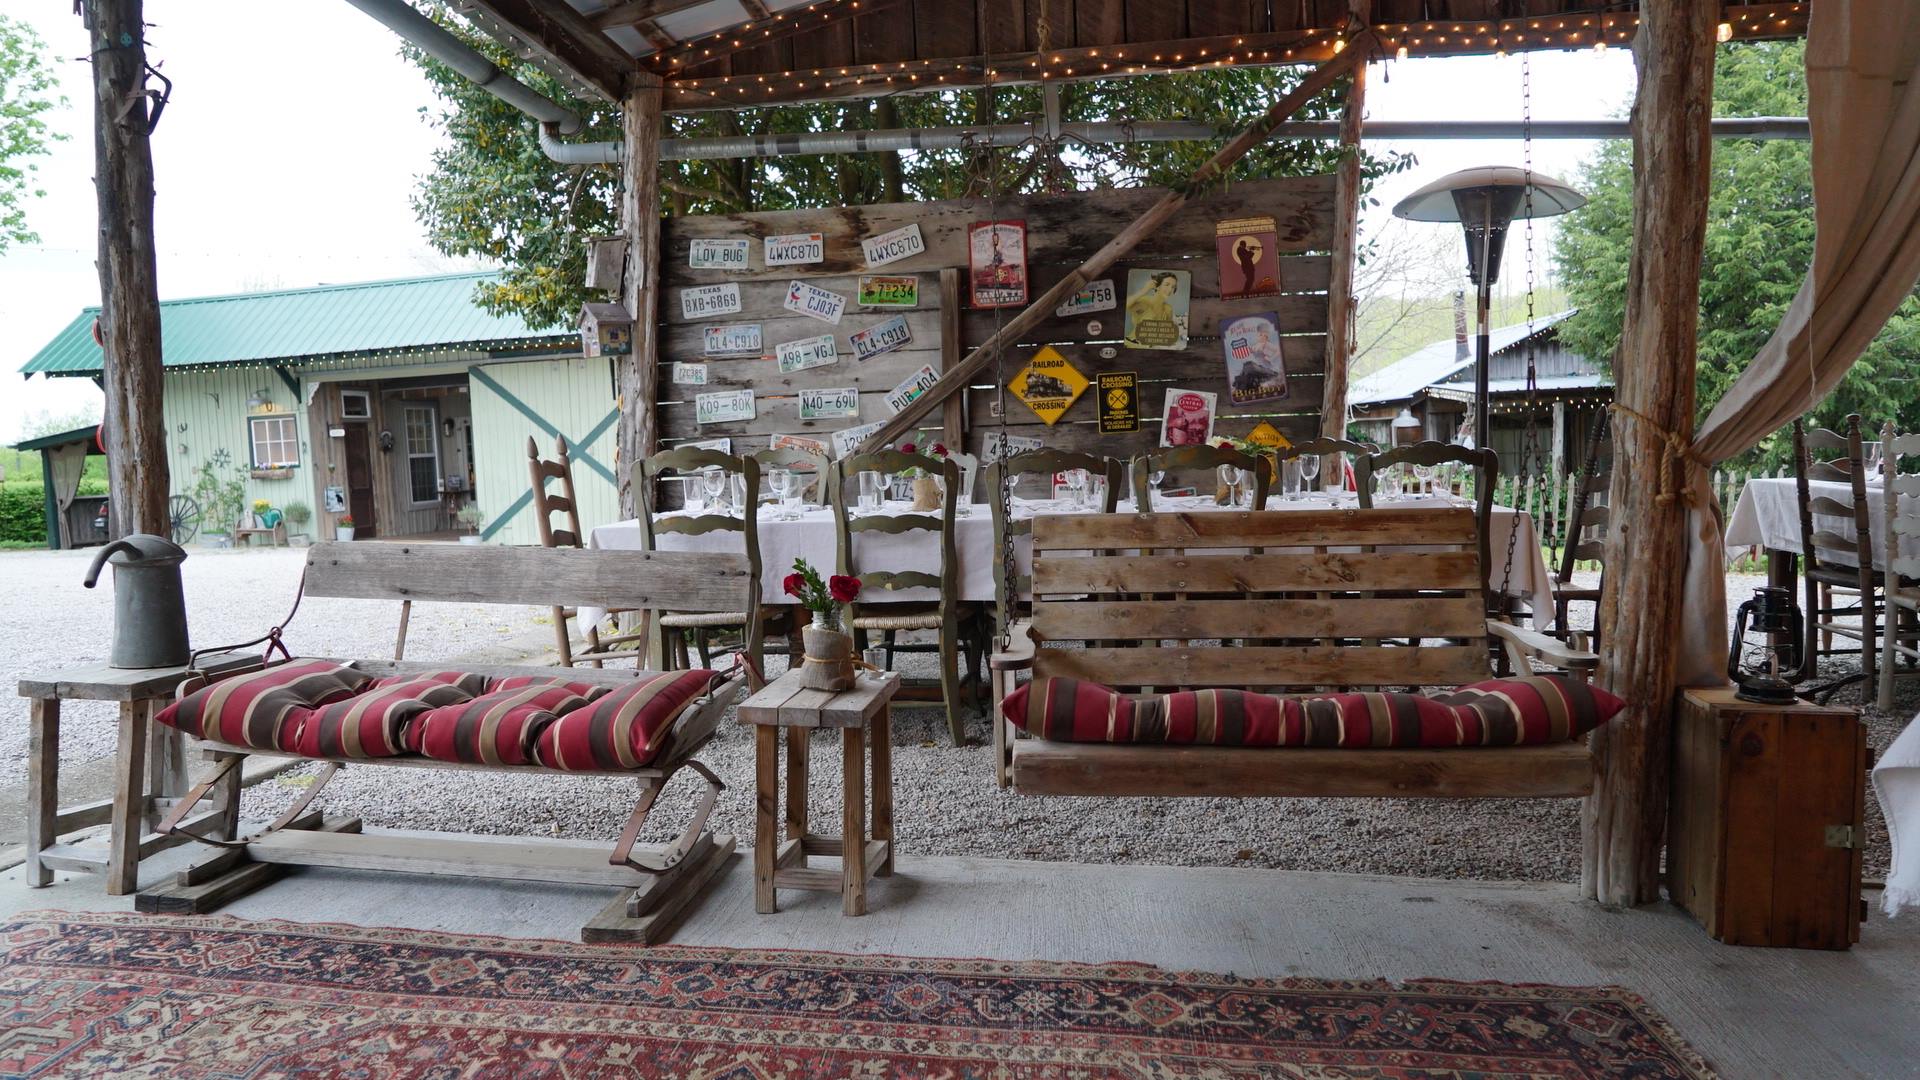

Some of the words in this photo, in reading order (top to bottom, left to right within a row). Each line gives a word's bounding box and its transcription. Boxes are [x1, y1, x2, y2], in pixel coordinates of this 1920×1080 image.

[769, 244, 819, 260] 4WXC870
[869, 235, 919, 262] 4WXC870
[696, 249, 716, 261] LOV
[723, 249, 743, 262] BUG
[699, 287, 721, 295] TEXAS
[808, 287, 830, 299] TEXAS
[1089, 288, 1111, 303] 758
[1032, 360, 1065, 368] RAILROAD
[891, 390, 915, 412] PUB
[916, 372, 938, 393] 404
[1235, 387, 1254, 398] BIG
[1032, 402, 1066, 410] CROSSING
[1179, 398, 1202, 406] CENTRAL
